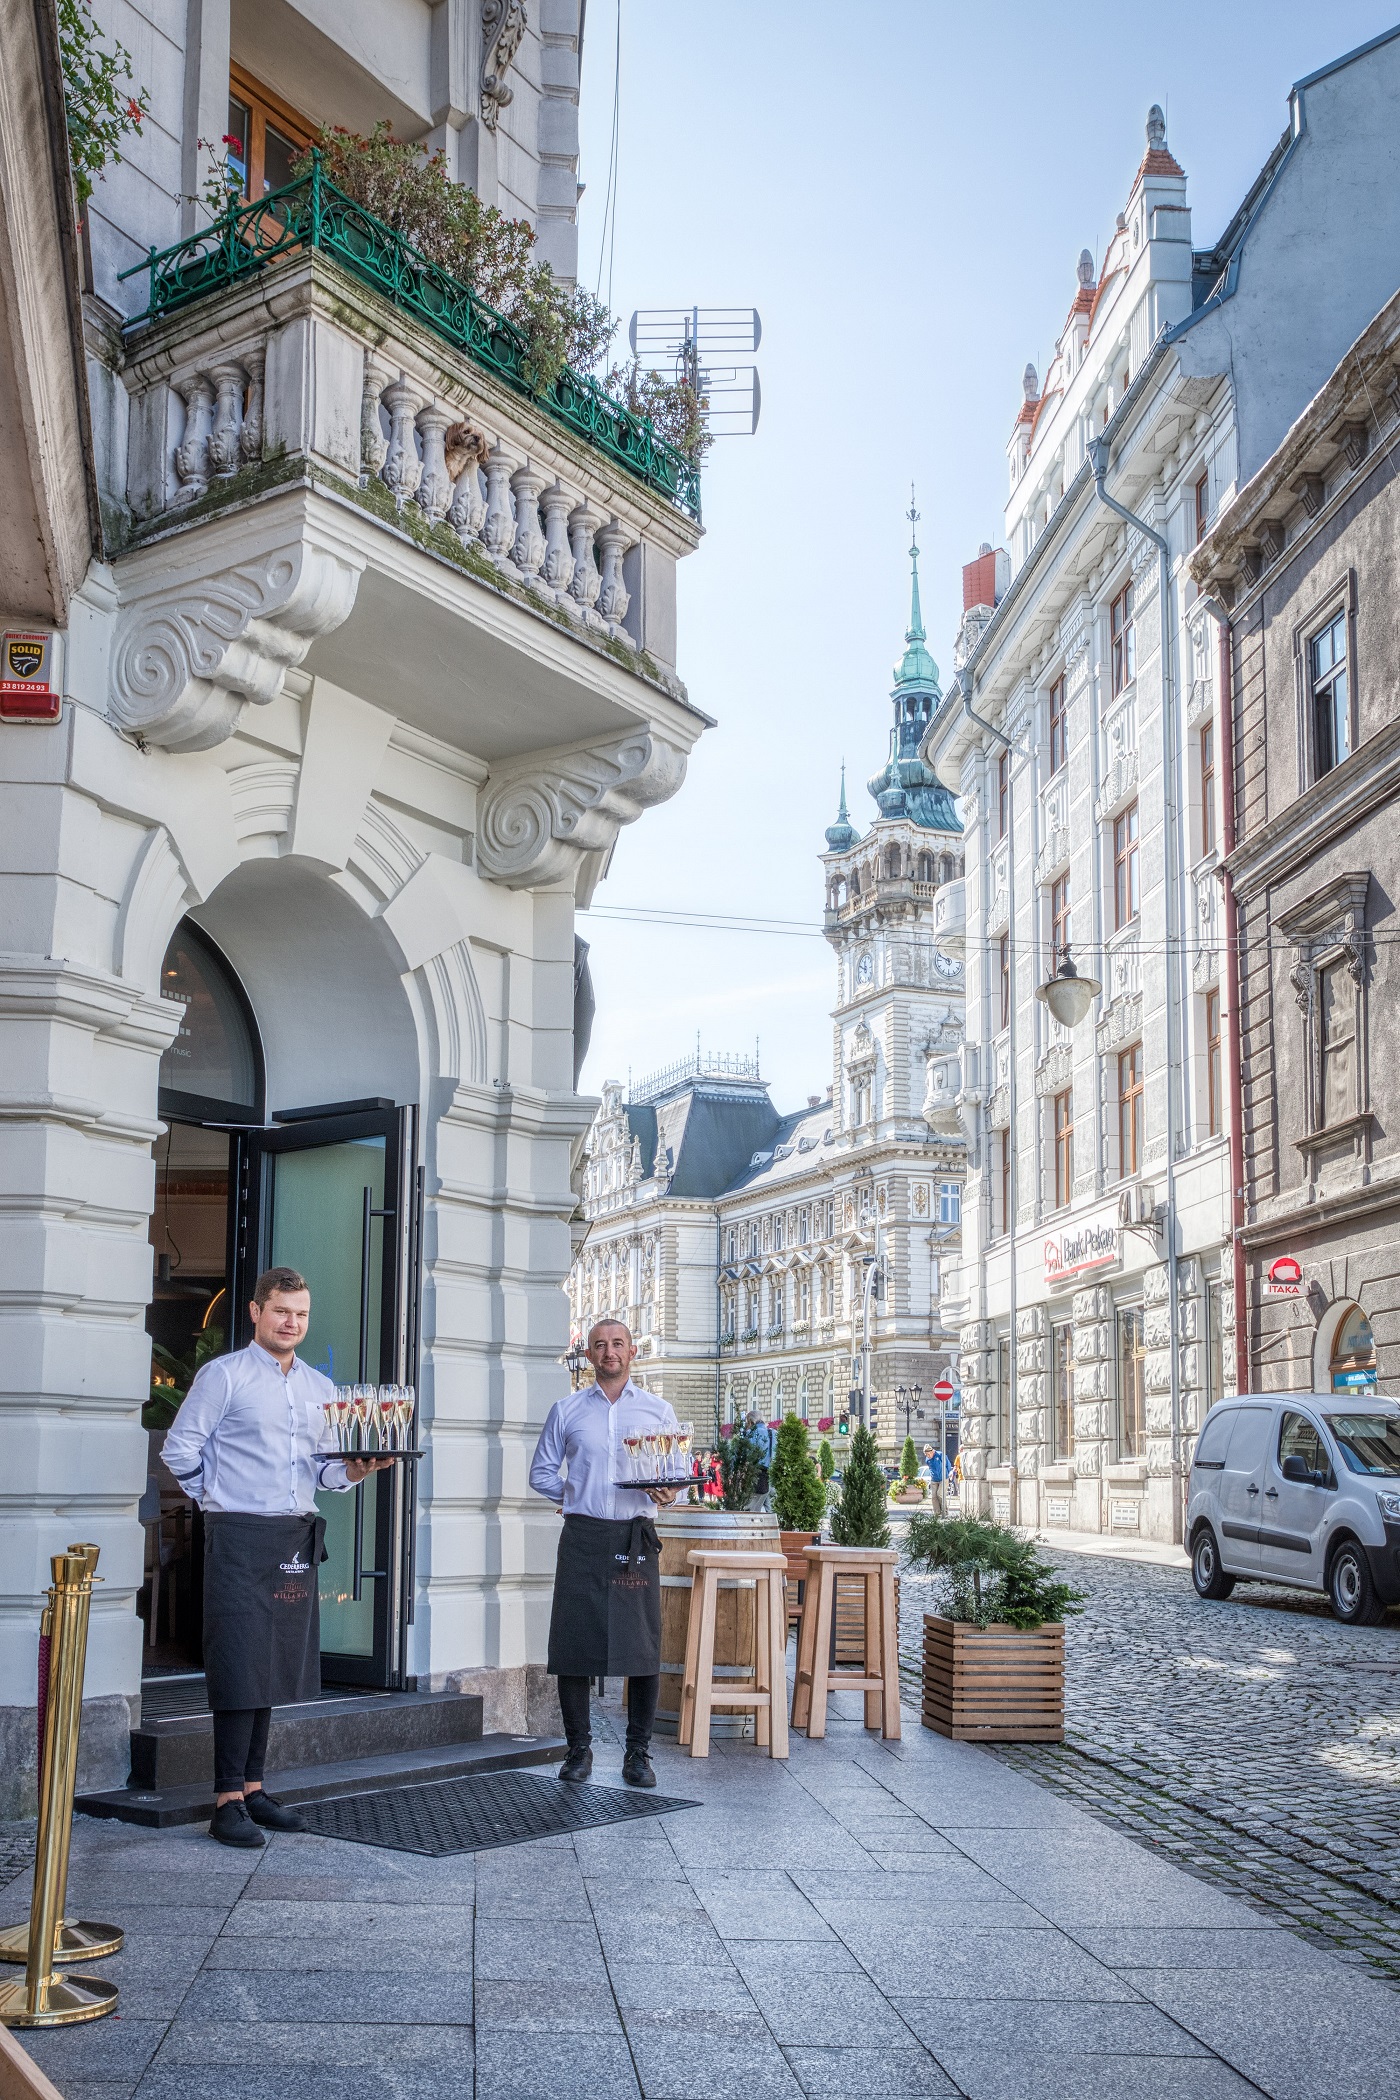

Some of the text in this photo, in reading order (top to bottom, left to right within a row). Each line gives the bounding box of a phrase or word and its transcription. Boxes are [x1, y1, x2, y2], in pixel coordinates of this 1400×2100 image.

[11, 645, 41, 654] SOLID
[171, 1047, 191, 1057] music
[1064, 1224, 1114, 1262] Bank Pekao
